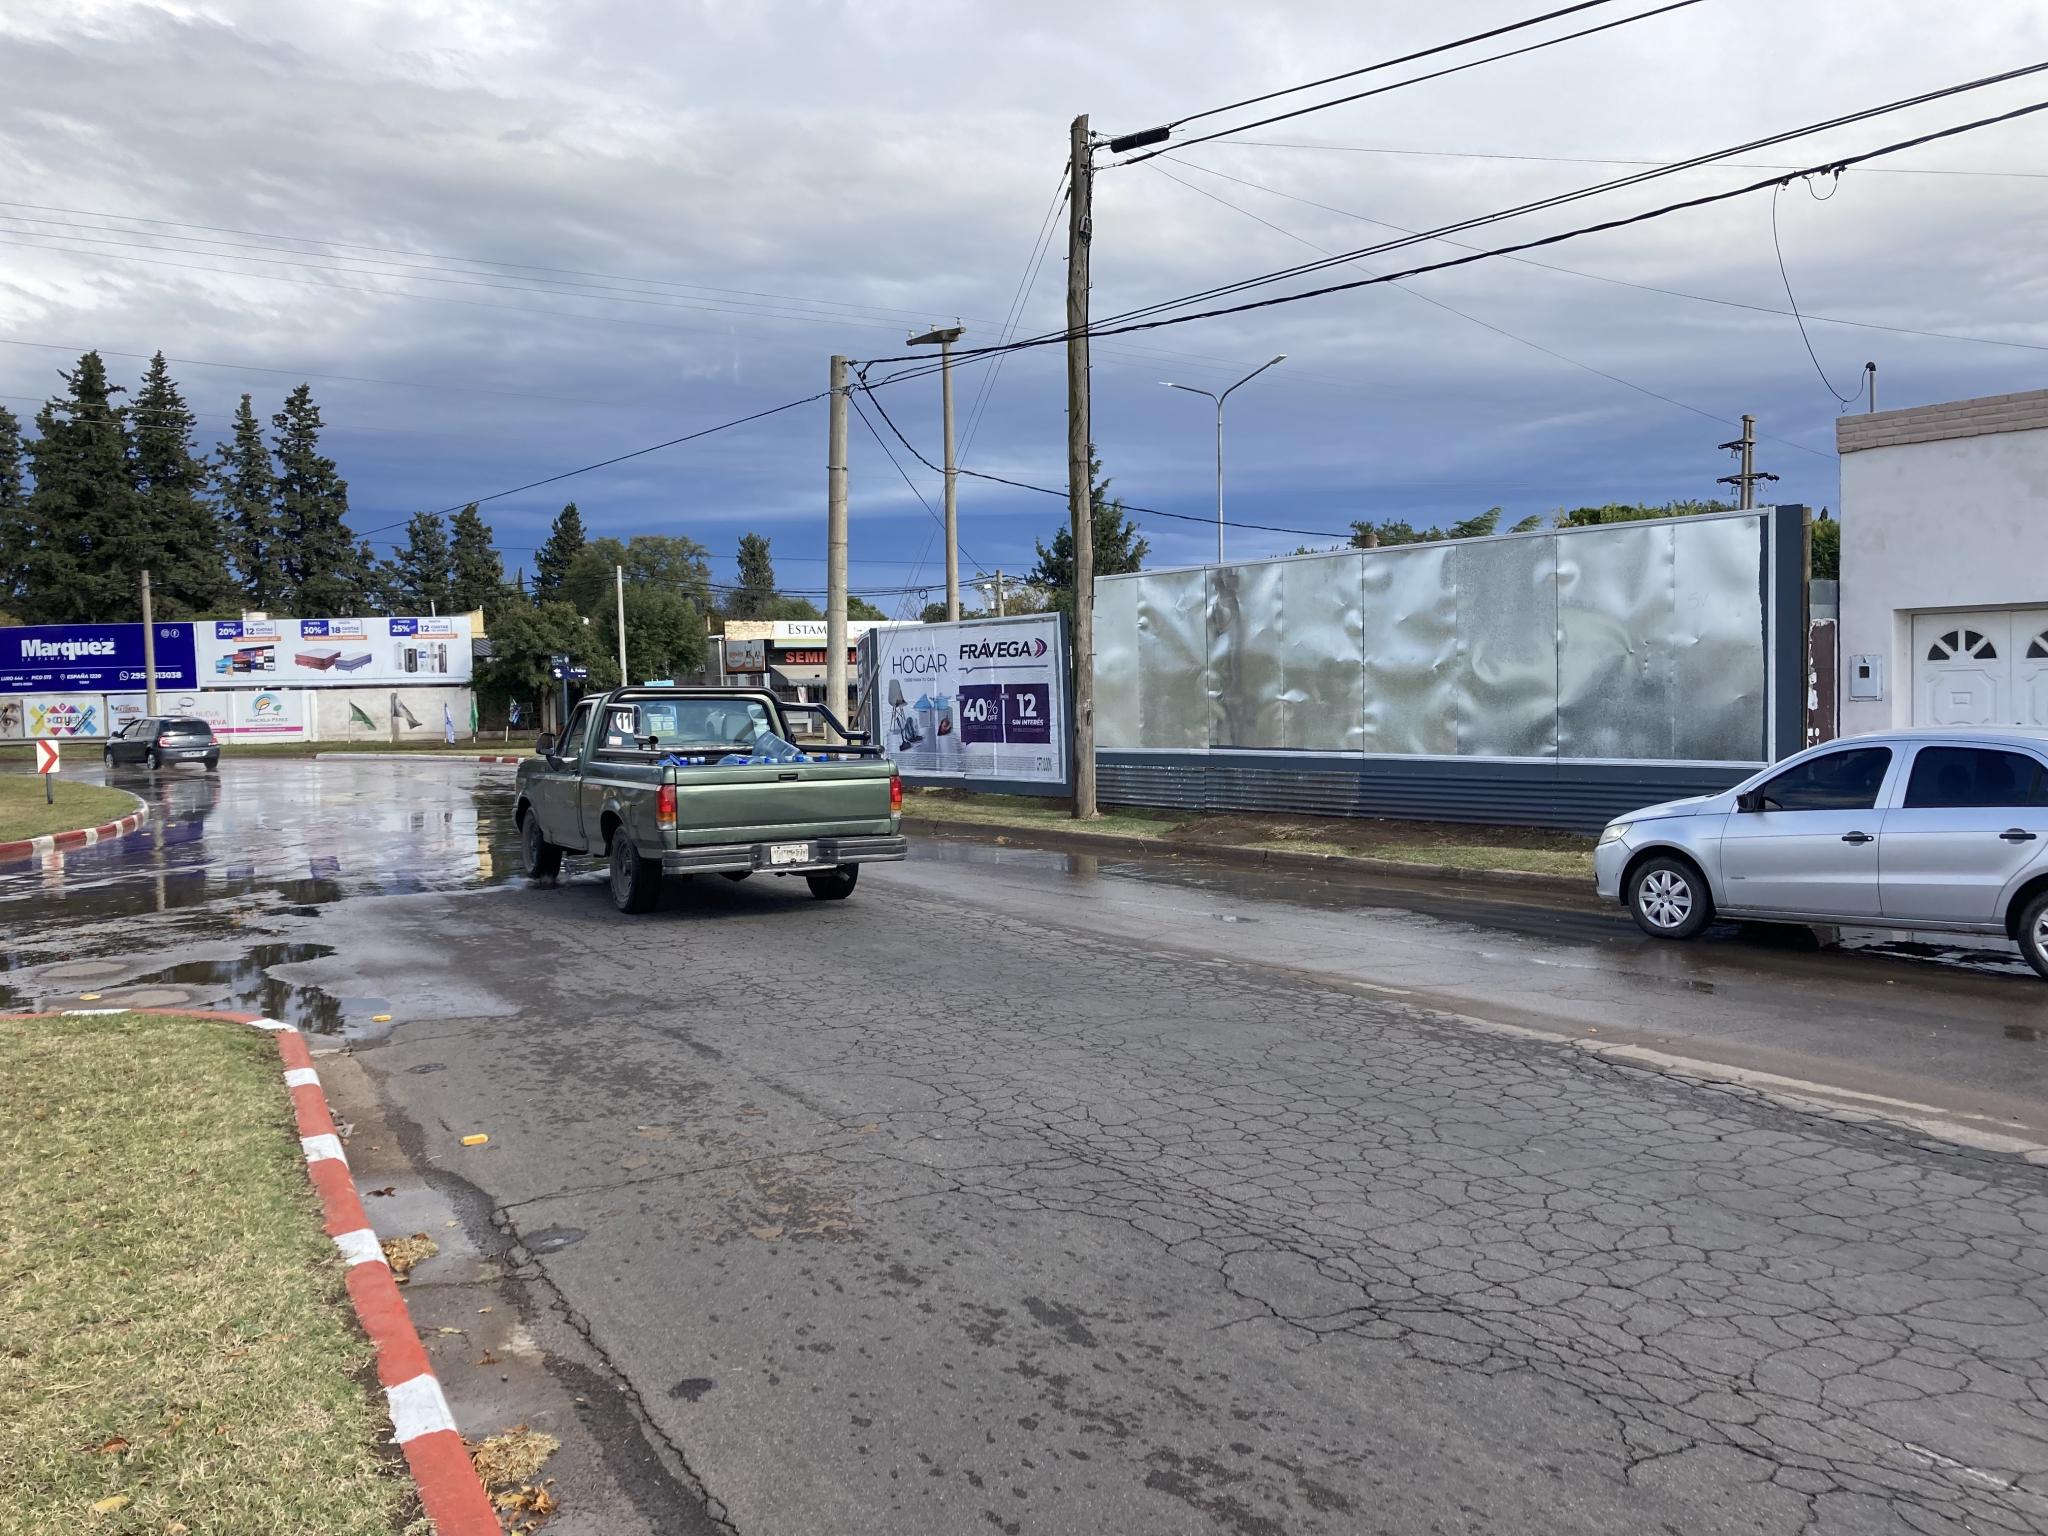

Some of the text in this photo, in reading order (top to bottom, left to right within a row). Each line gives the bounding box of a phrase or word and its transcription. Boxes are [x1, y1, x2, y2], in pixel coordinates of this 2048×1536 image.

[218, 627, 236, 636] 20%
[245, 627, 255, 635] 12
[303, 626, 322, 634] 30%
[788, 624, 827, 635] ESTAM
[21, 638, 115, 660] Marquez
[960, 637, 1032, 660] FRÁVEGA
[892, 653, 948, 674] HOGAR
[67, 672, 89, 680] ESPAÑA
[1016, 693, 1037, 717] 12
[617, 712, 633, 730] 11
[1021, 717, 1044, 726] INTERÉS
